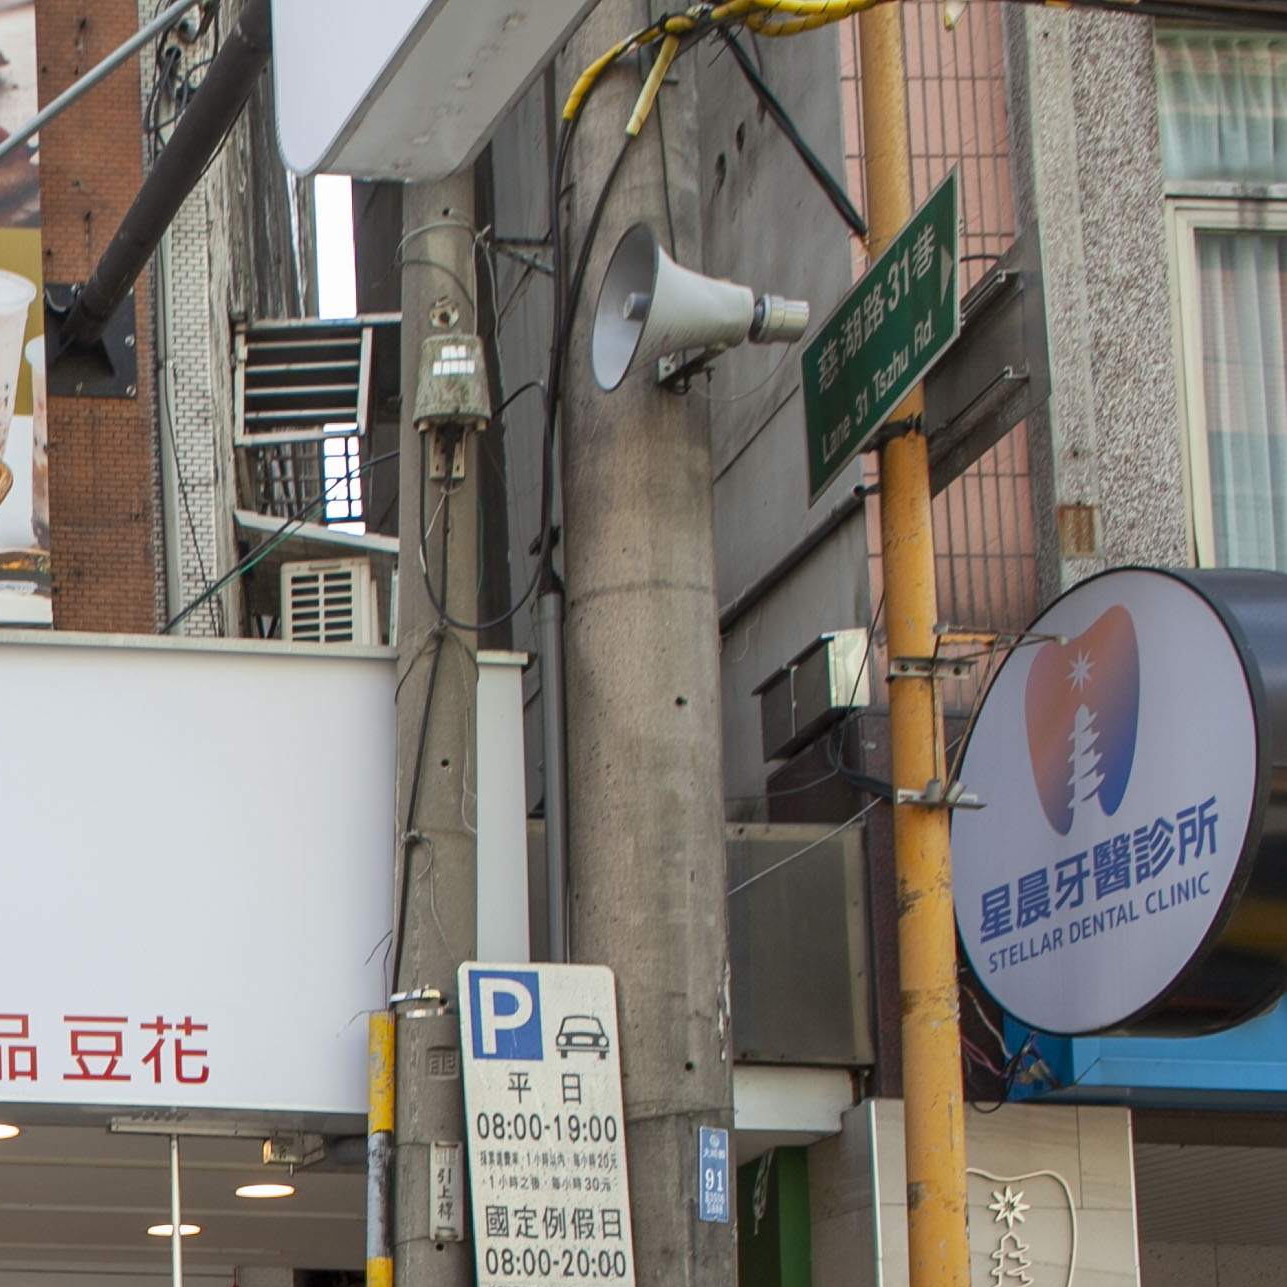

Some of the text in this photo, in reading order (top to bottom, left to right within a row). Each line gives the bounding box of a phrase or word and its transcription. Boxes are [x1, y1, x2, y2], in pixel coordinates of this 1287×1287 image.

[822, 416, 851, 464] Lane
[855, 385, 869, 426] 31
[979, 795, 1219, 944] 星晨牙醫診所
[988, 870, 1212, 974] STELLAR DENTAL CLINIC
[477, 978, 533, 1054] P
[477, 1112, 618, 1143] 08:00-19:00
[705, 1168, 724, 1192] 91
[485, 1205, 622, 1240] 國定例假日
[486, 1248, 627, 1278] 08:00-20:00
